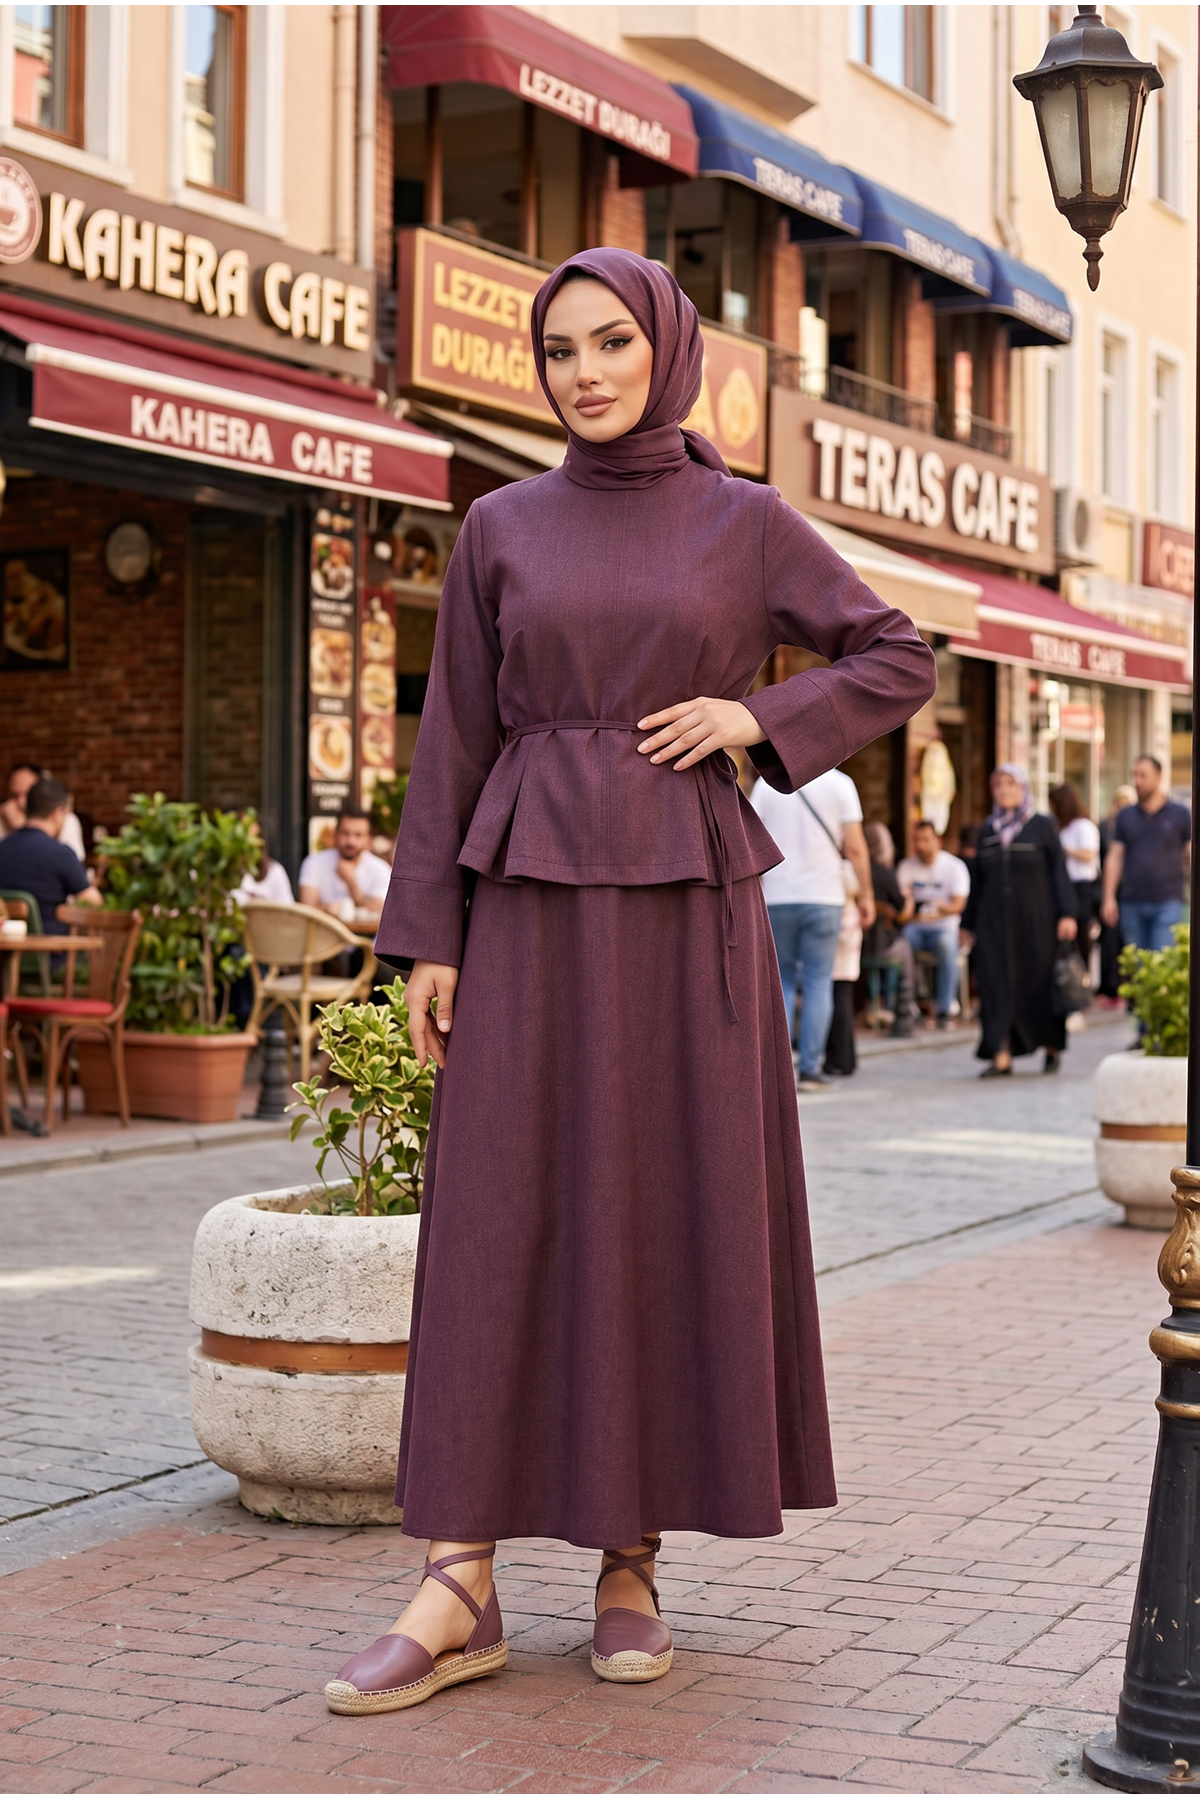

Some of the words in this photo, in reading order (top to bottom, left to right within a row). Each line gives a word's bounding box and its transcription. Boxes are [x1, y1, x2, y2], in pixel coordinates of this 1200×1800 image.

[519, 63, 598, 124] LEZZET
[599, 100, 671, 160] DURAĞI
[48, 191, 249, 319] KAHERA
[263, 261, 370, 352] CAFE
[433, 262, 532, 333] LEZZET
[432, 324, 535, 393] DURAĞI
[131, 394, 274, 465] KAHERA
[291, 432, 373, 484] CAFE
[812, 418, 946, 528] TERAS
[951, 462, 1039, 553] CAFE
